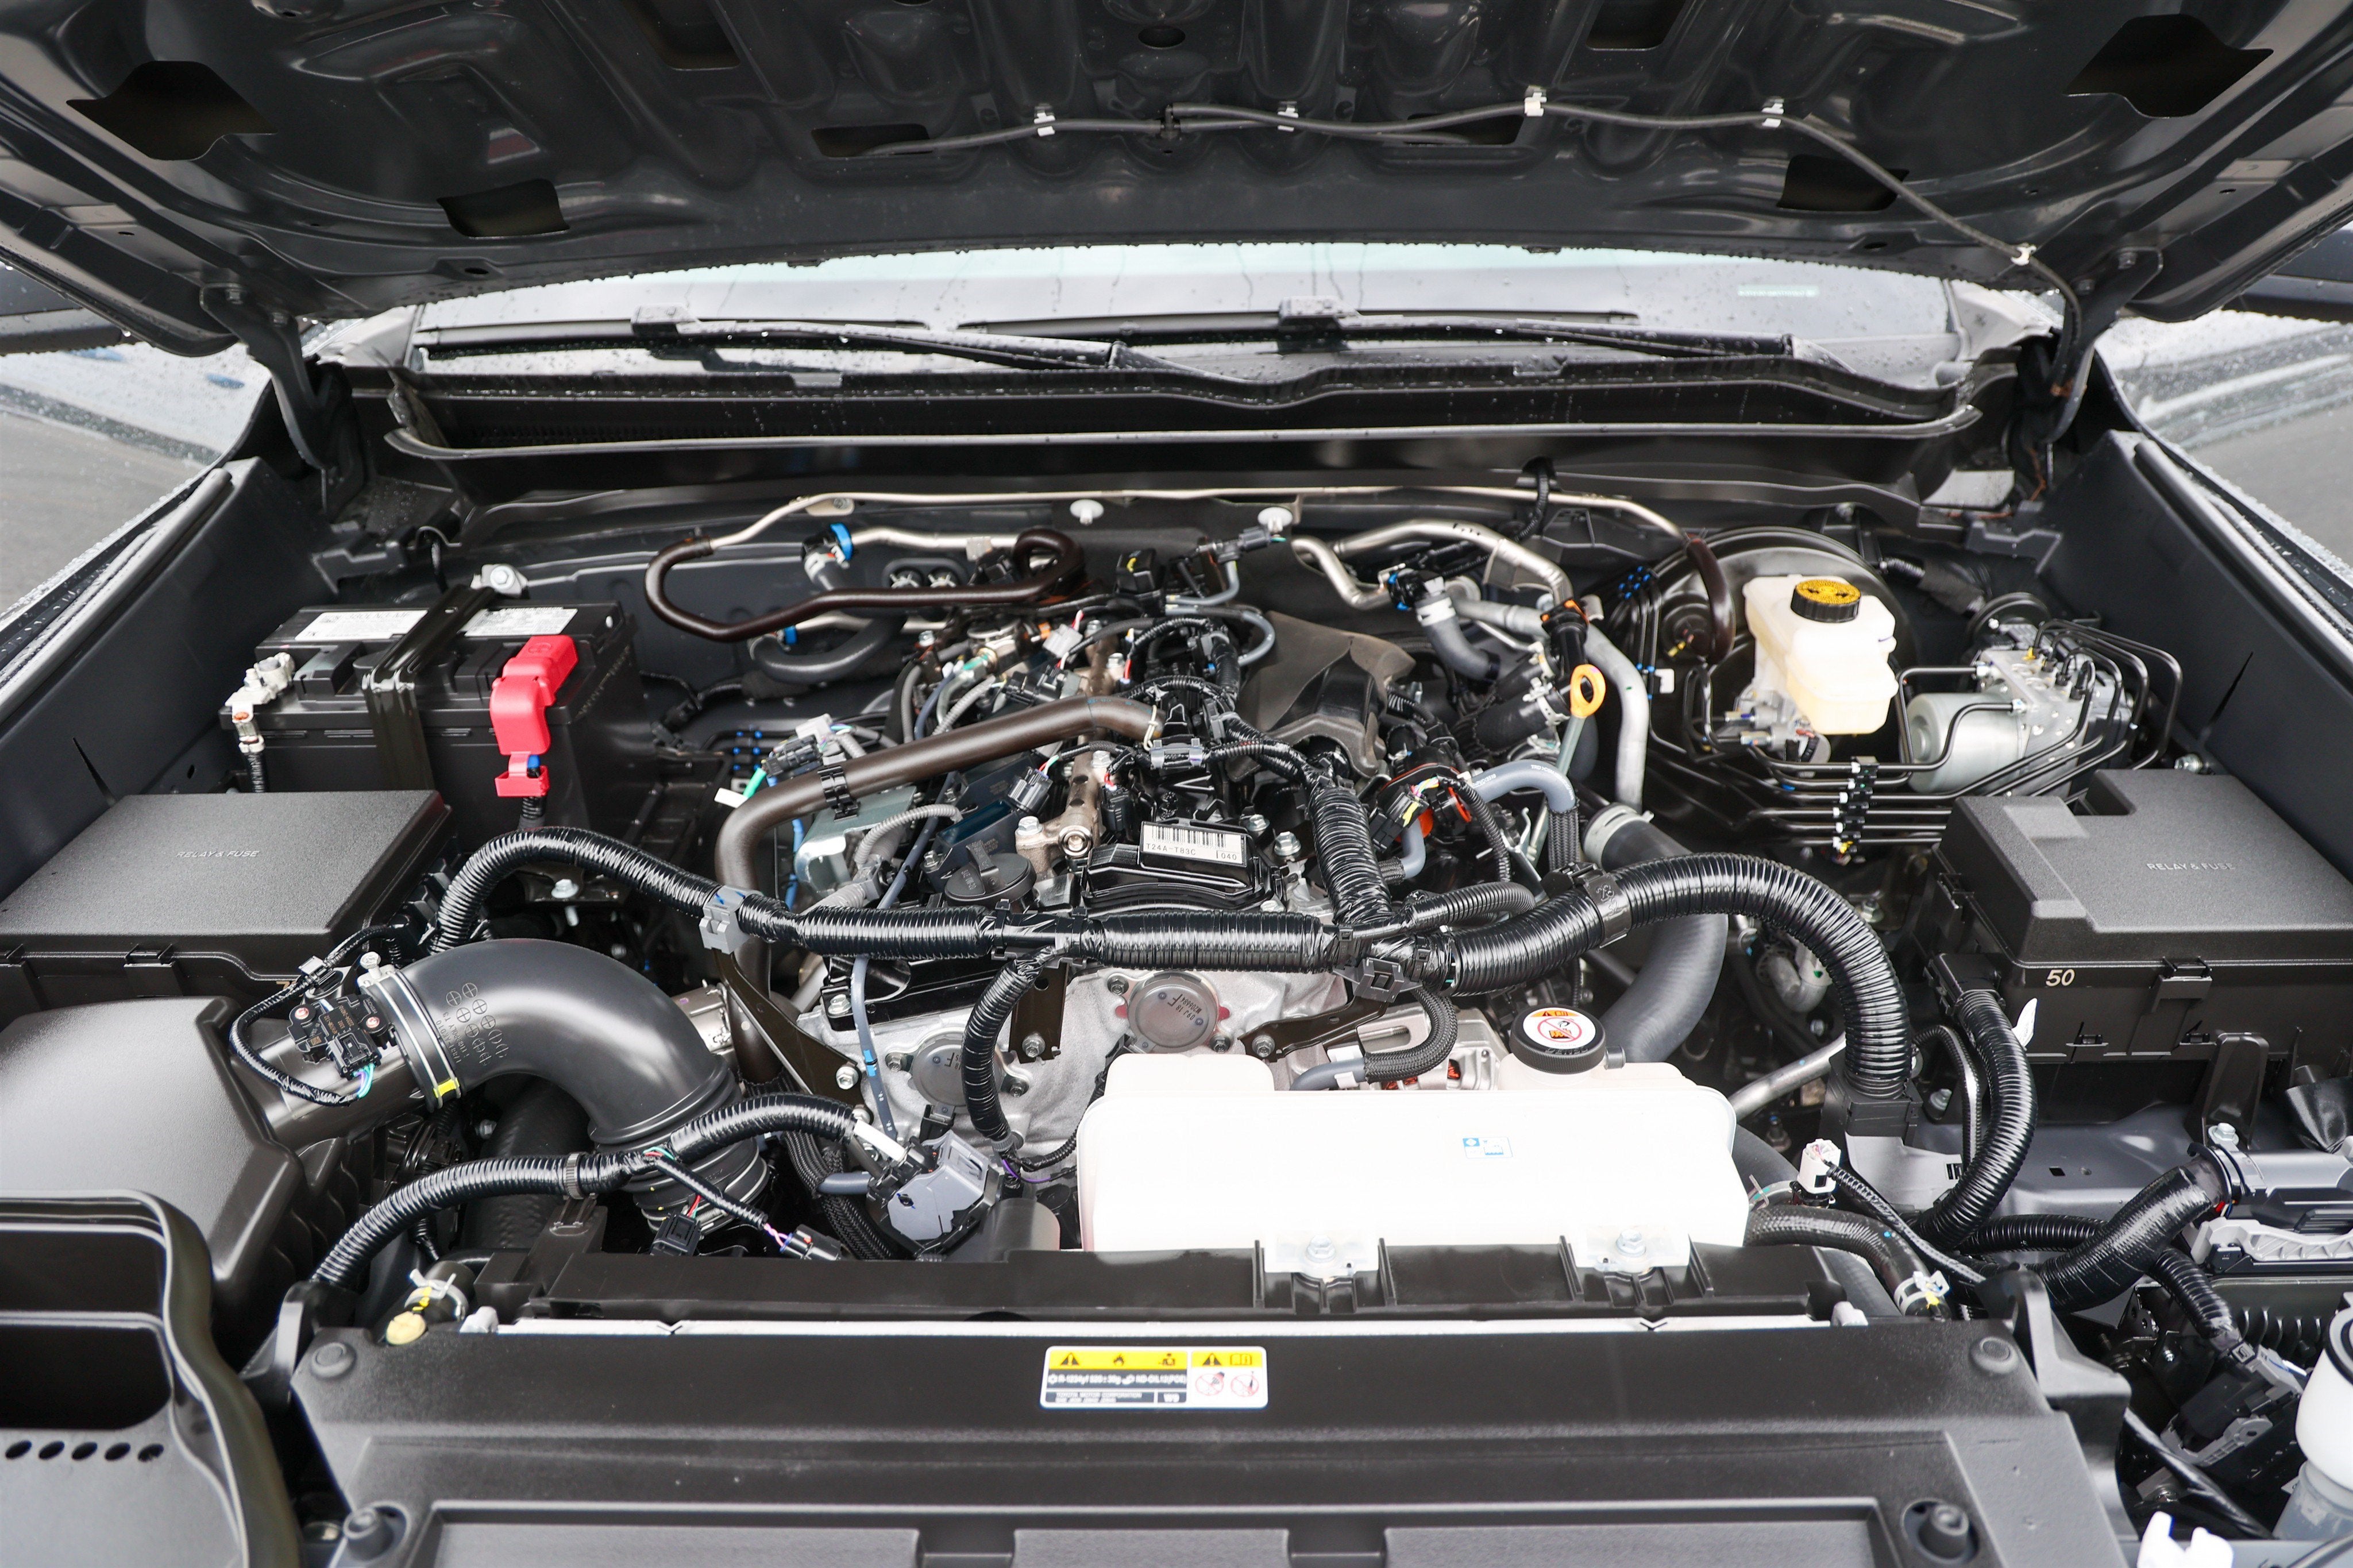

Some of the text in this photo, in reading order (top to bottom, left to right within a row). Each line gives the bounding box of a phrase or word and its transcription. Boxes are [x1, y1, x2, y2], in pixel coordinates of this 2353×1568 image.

[1146, 843, 1196, 855] T24A-T83C
[1221, 852, 1237, 860] 040
[2046, 970, 2074, 986] 50
